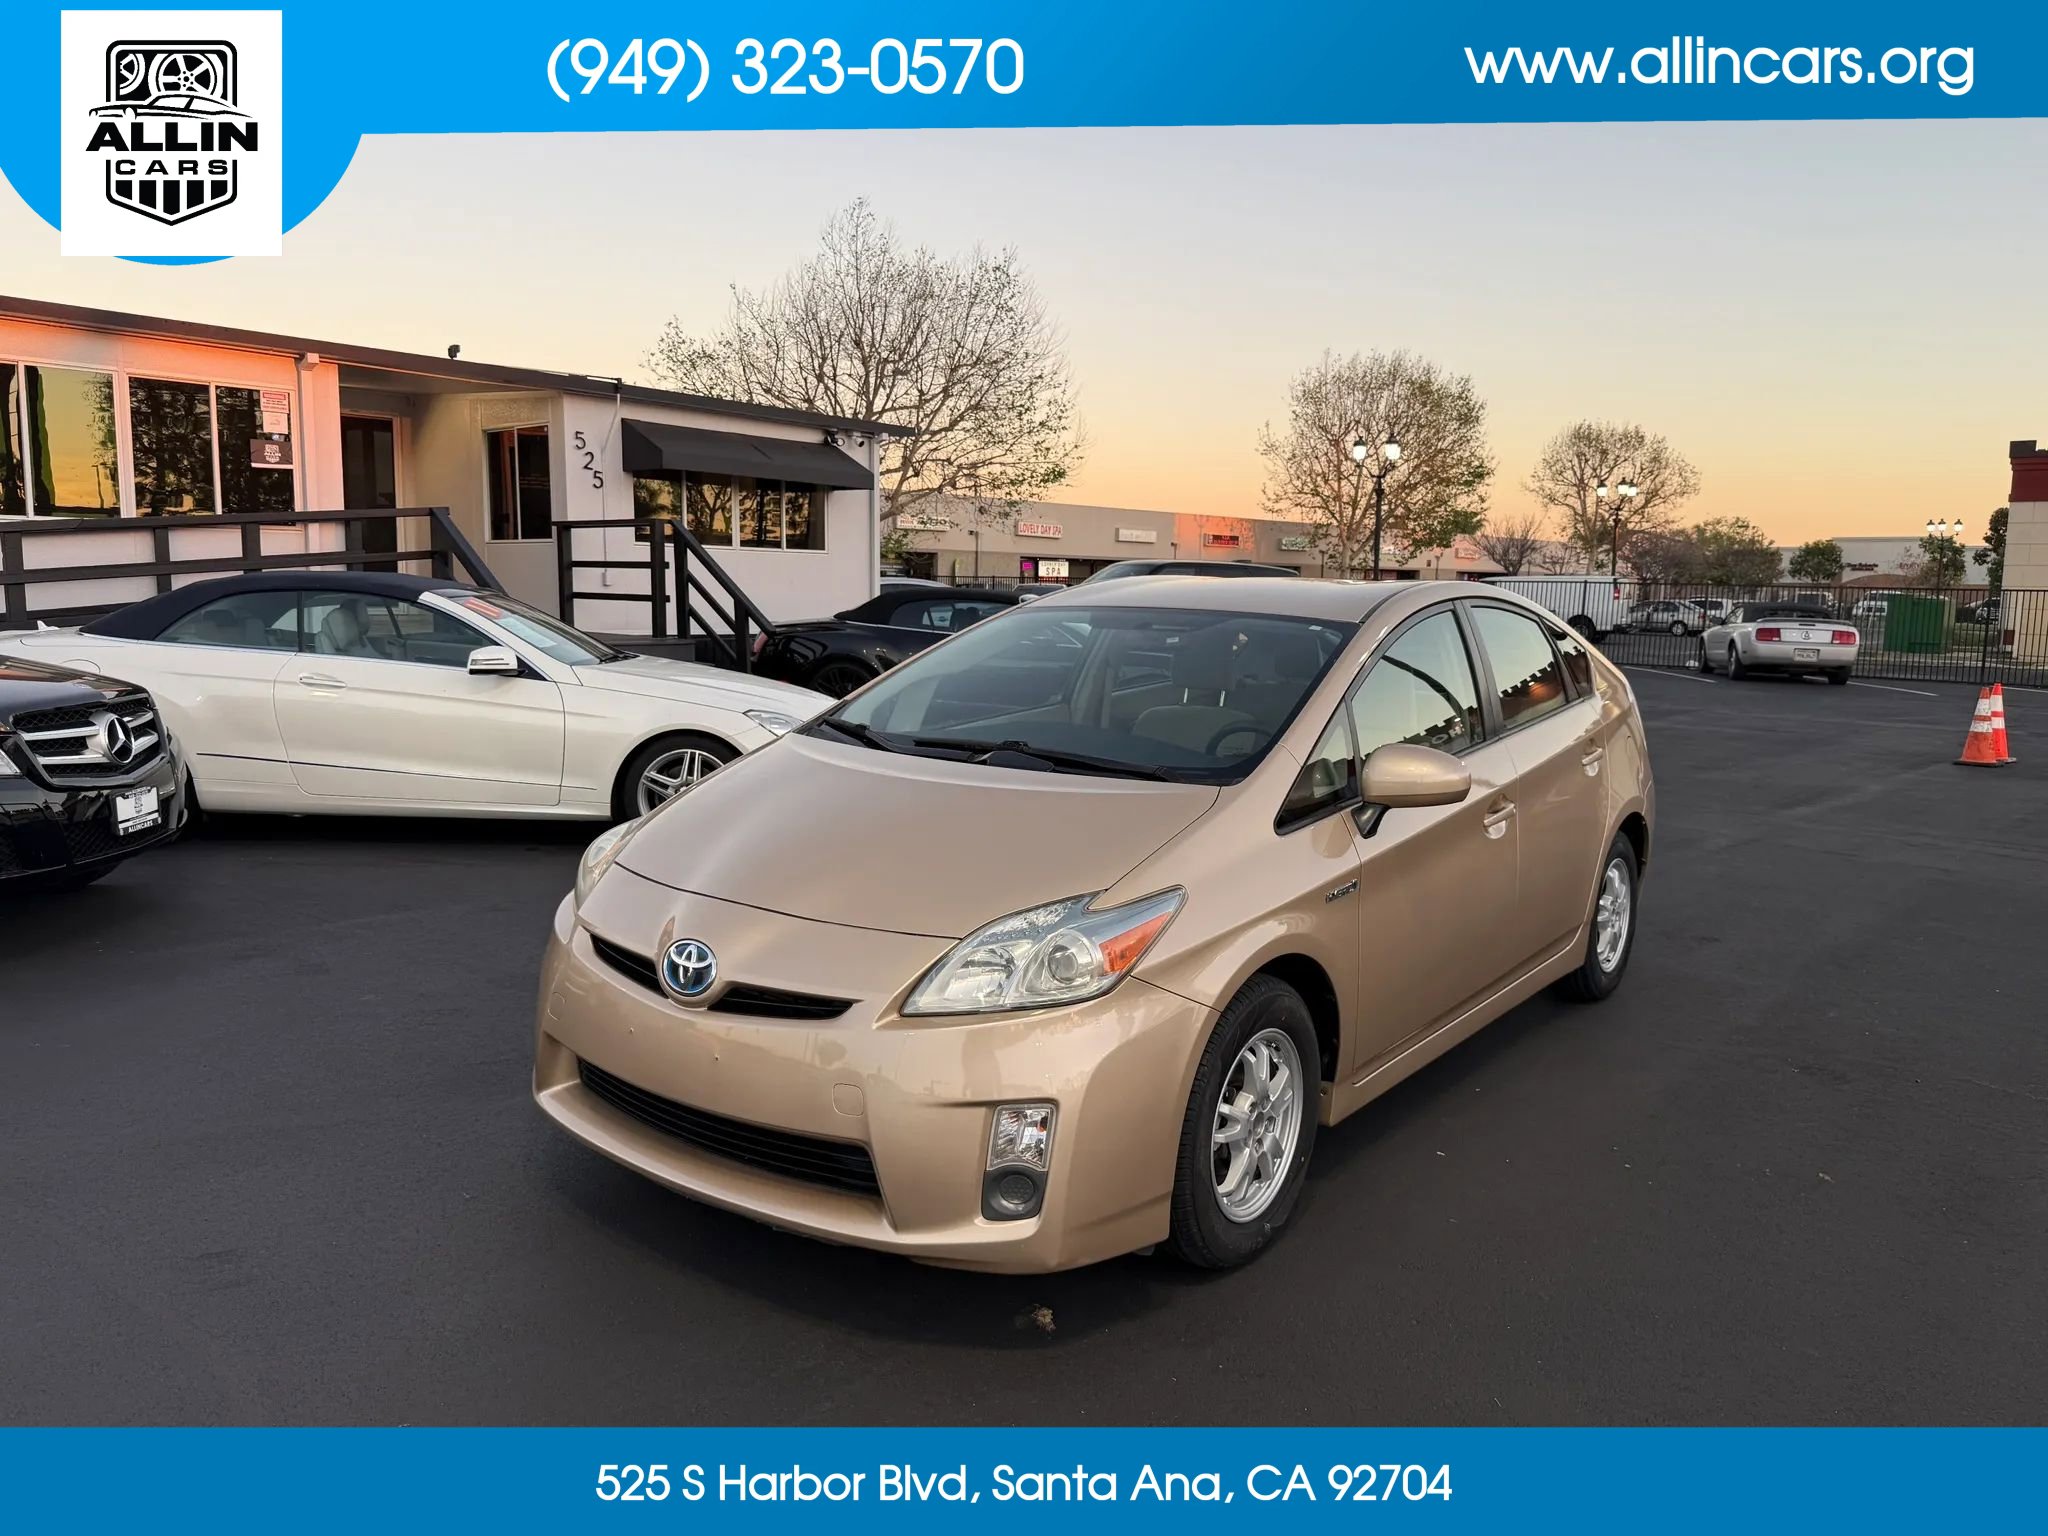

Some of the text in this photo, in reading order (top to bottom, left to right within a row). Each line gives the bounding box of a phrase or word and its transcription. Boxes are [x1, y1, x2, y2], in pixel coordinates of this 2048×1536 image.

[1019, 522, 1062, 536] LOVELY DAY SPA
[1045, 567, 1061, 576] SPA
